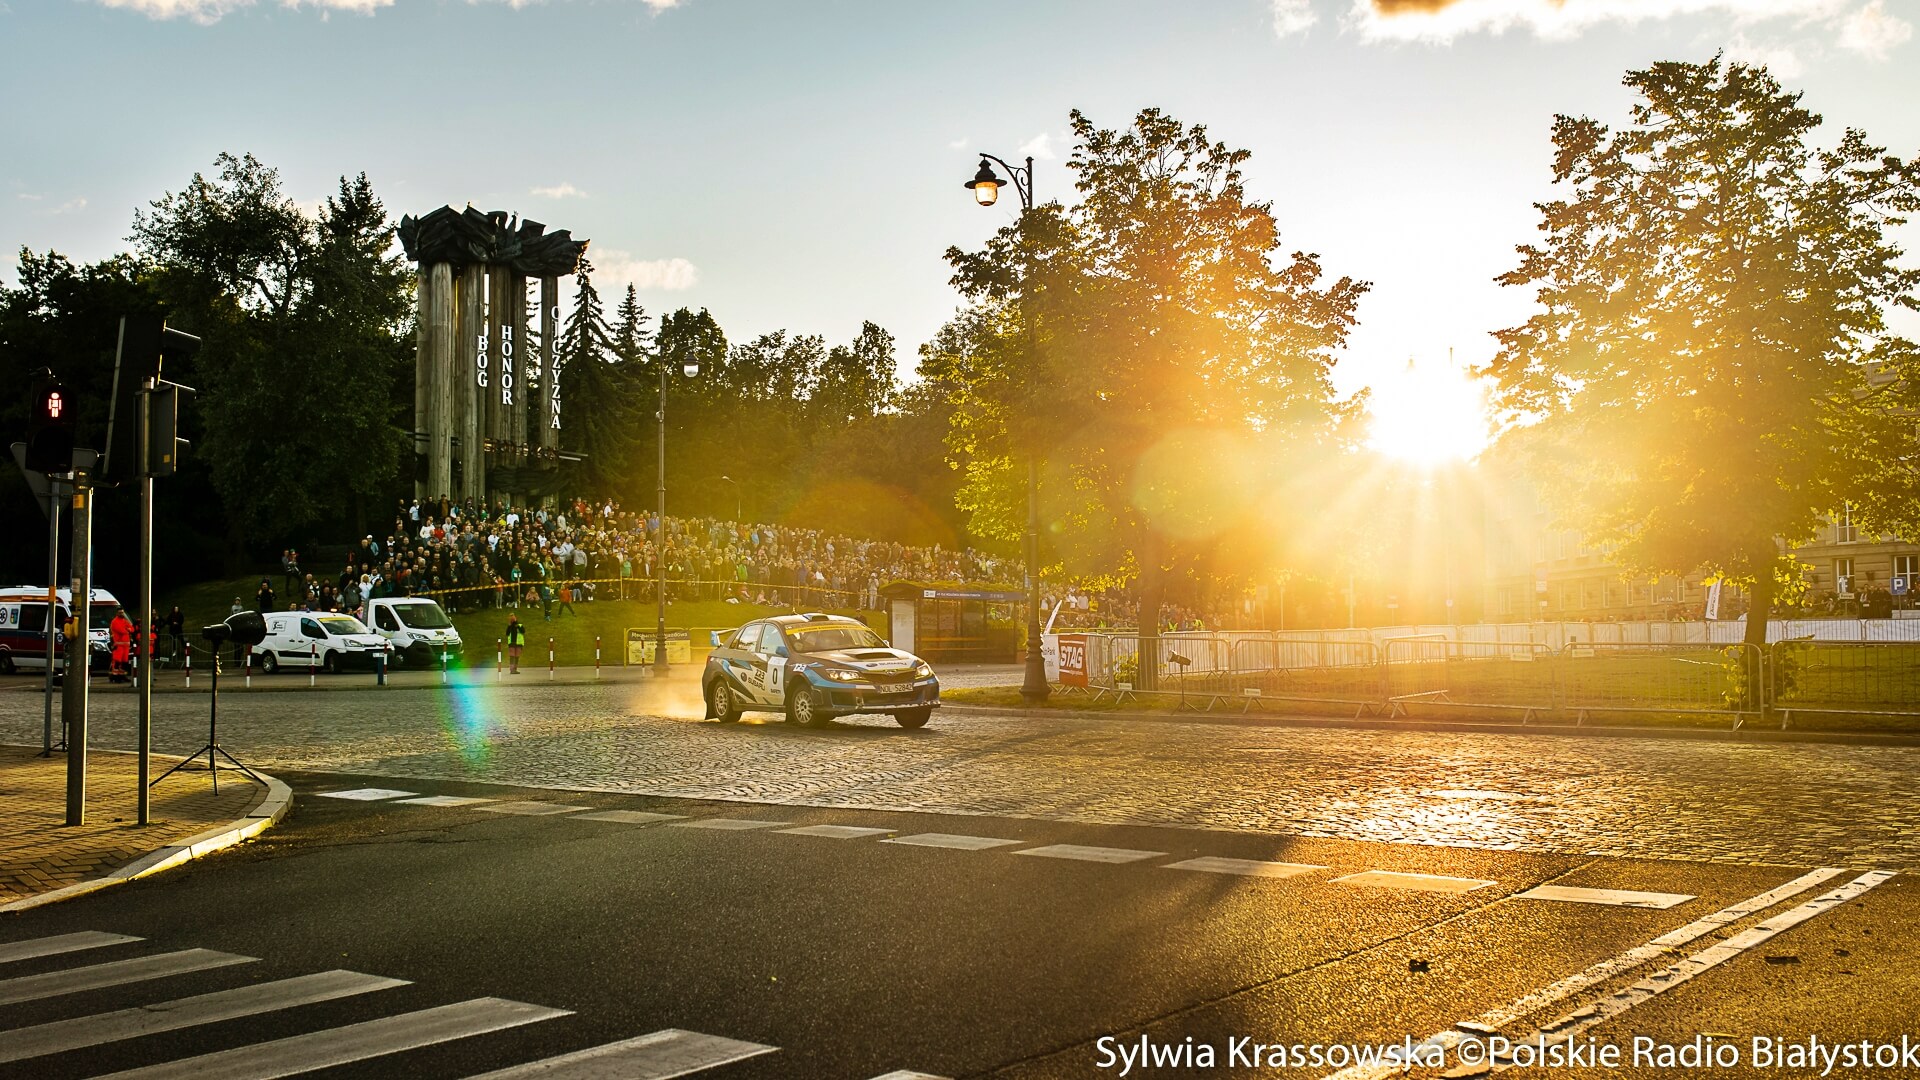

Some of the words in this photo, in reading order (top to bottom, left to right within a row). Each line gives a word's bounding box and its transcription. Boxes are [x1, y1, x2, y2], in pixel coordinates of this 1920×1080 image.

[501, 325, 513, 405] HONOR
[551, 305, 561, 429] OJCZYZNA
[1893, 578, 1904, 590] P
[1060, 646, 1083, 668] STAG
[748, 677, 766, 691] SUBARU
[772, 667, 778, 685] 0
